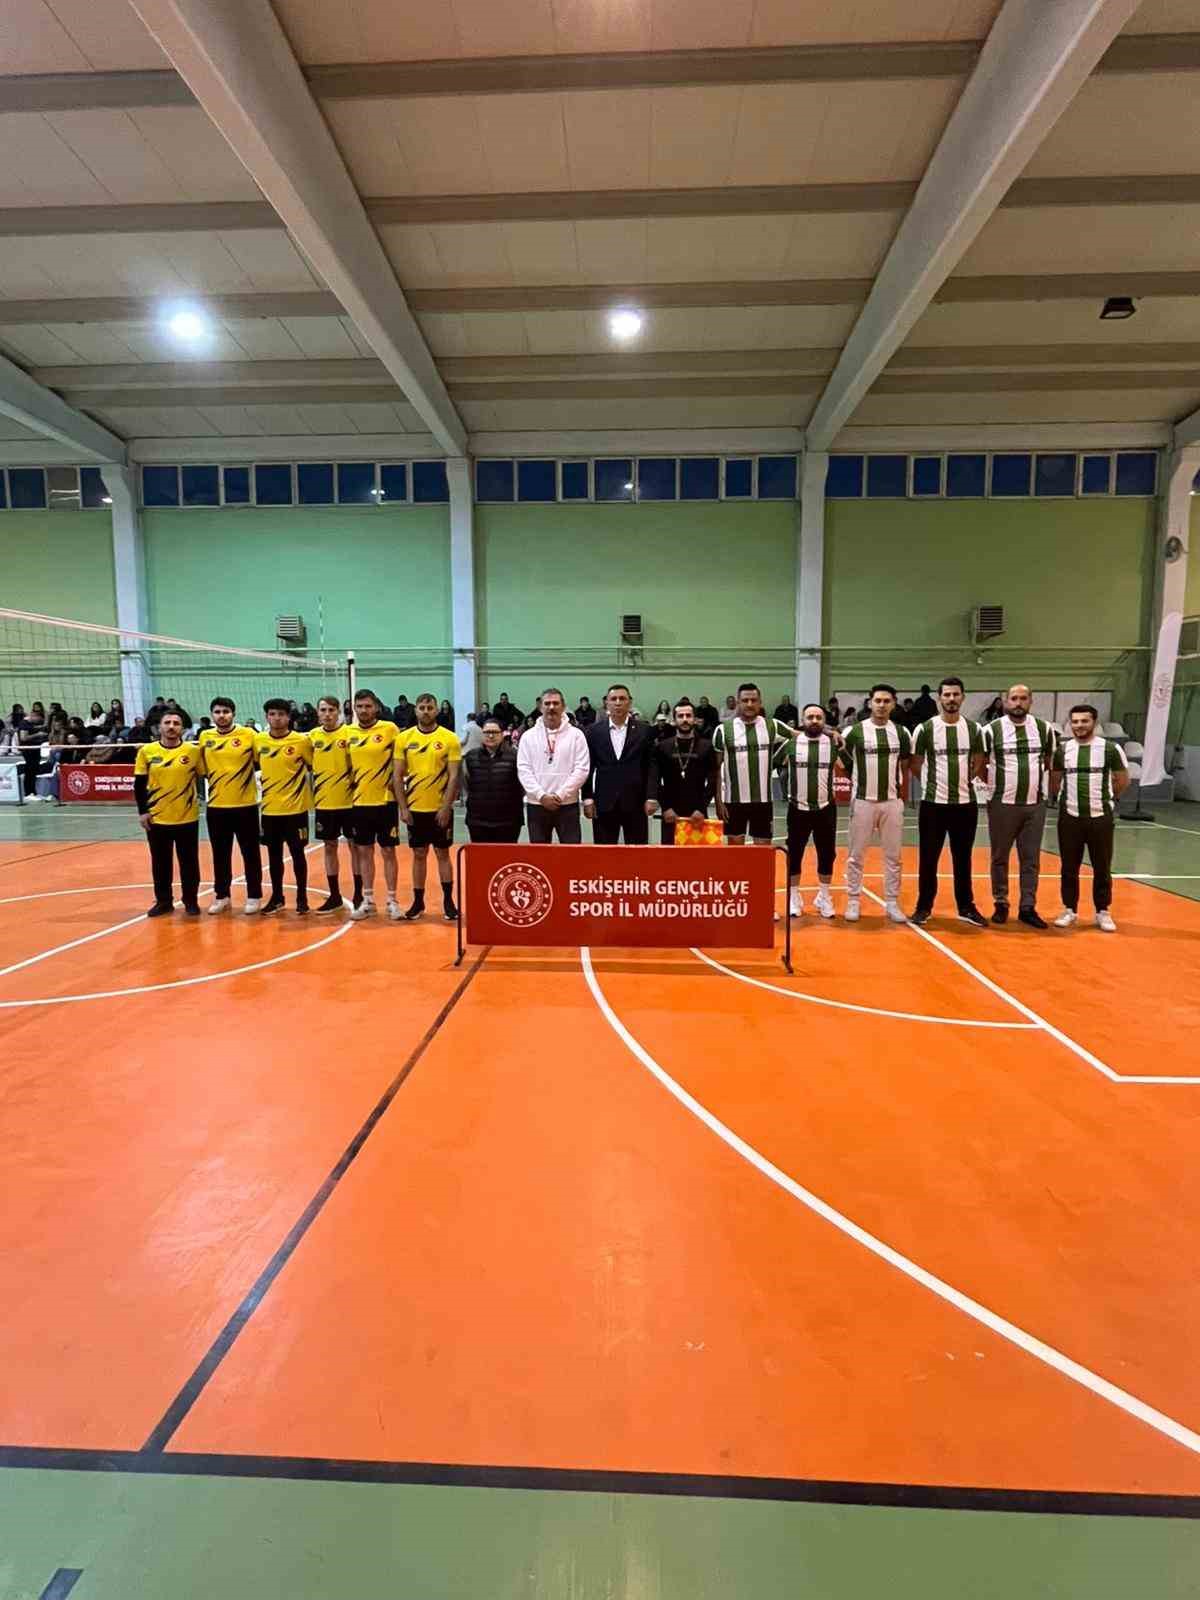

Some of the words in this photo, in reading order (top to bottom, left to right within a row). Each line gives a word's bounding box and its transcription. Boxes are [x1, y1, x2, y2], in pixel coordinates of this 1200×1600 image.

[569, 875, 651, 898] ESKİŞEHİR
[655, 877, 725, 899] GENÇLİK
[729, 880, 750, 895] VE
[569, 902, 614, 917] SPOR
[619, 898, 634, 917] İL
[639, 899, 748, 918] MÜDÜRLÜĞÜ
